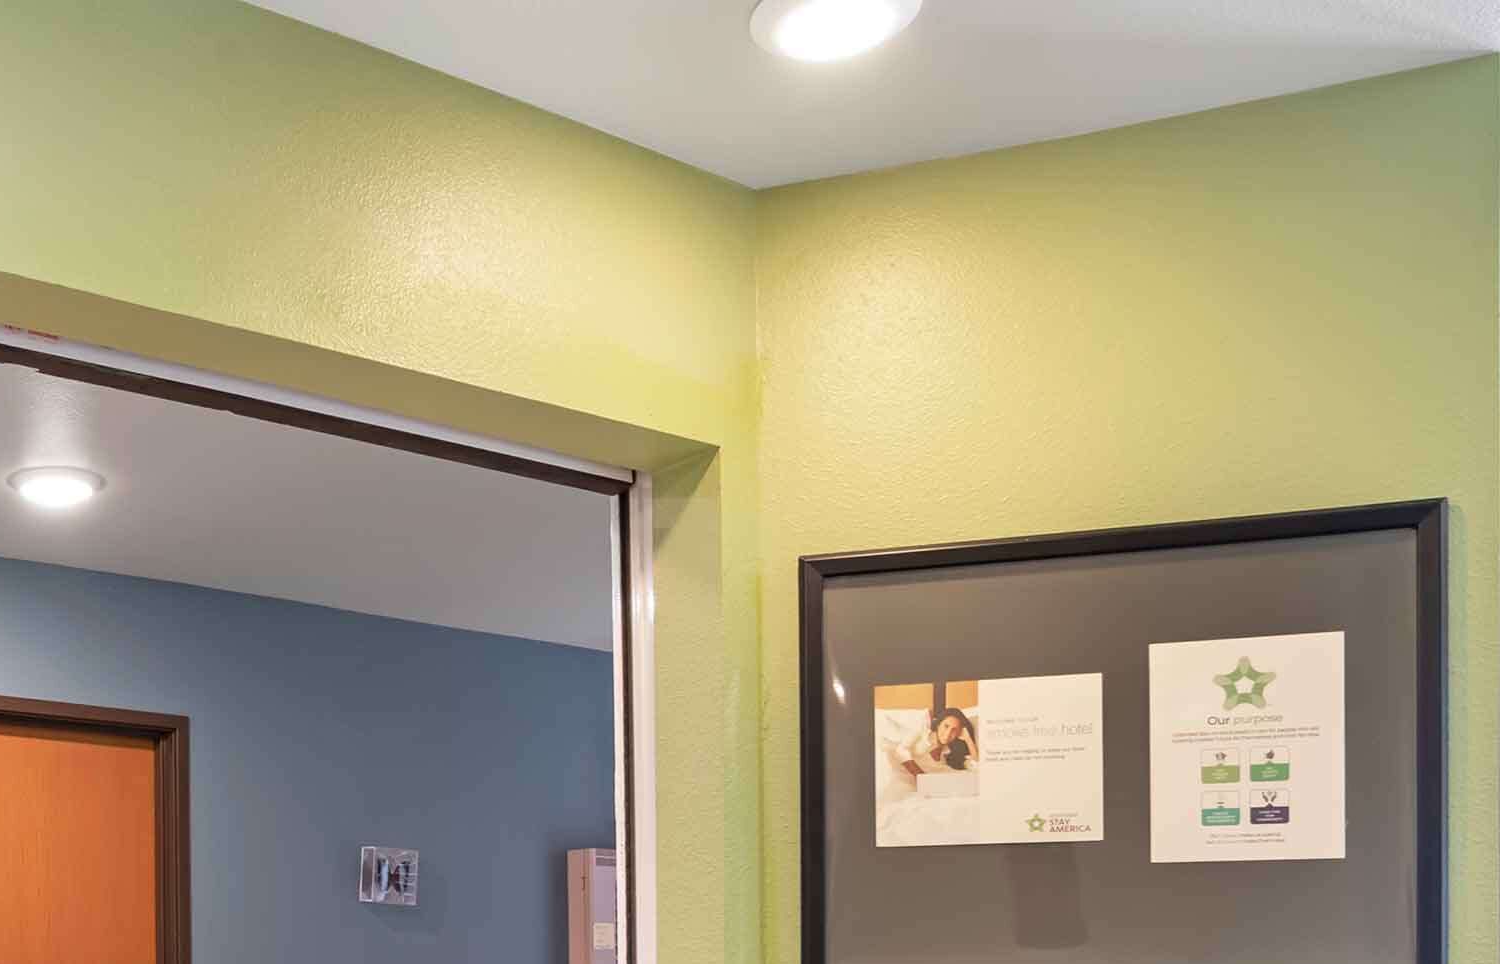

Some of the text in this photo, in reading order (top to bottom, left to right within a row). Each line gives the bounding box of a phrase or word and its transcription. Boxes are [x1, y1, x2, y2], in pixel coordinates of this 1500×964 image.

[1207, 714, 1284, 728] Our purpose
[1060, 720, 1093, 736] hotel
[1049, 818, 1070, 826] STAY
[1049, 824, 1092, 833] AMERICA
